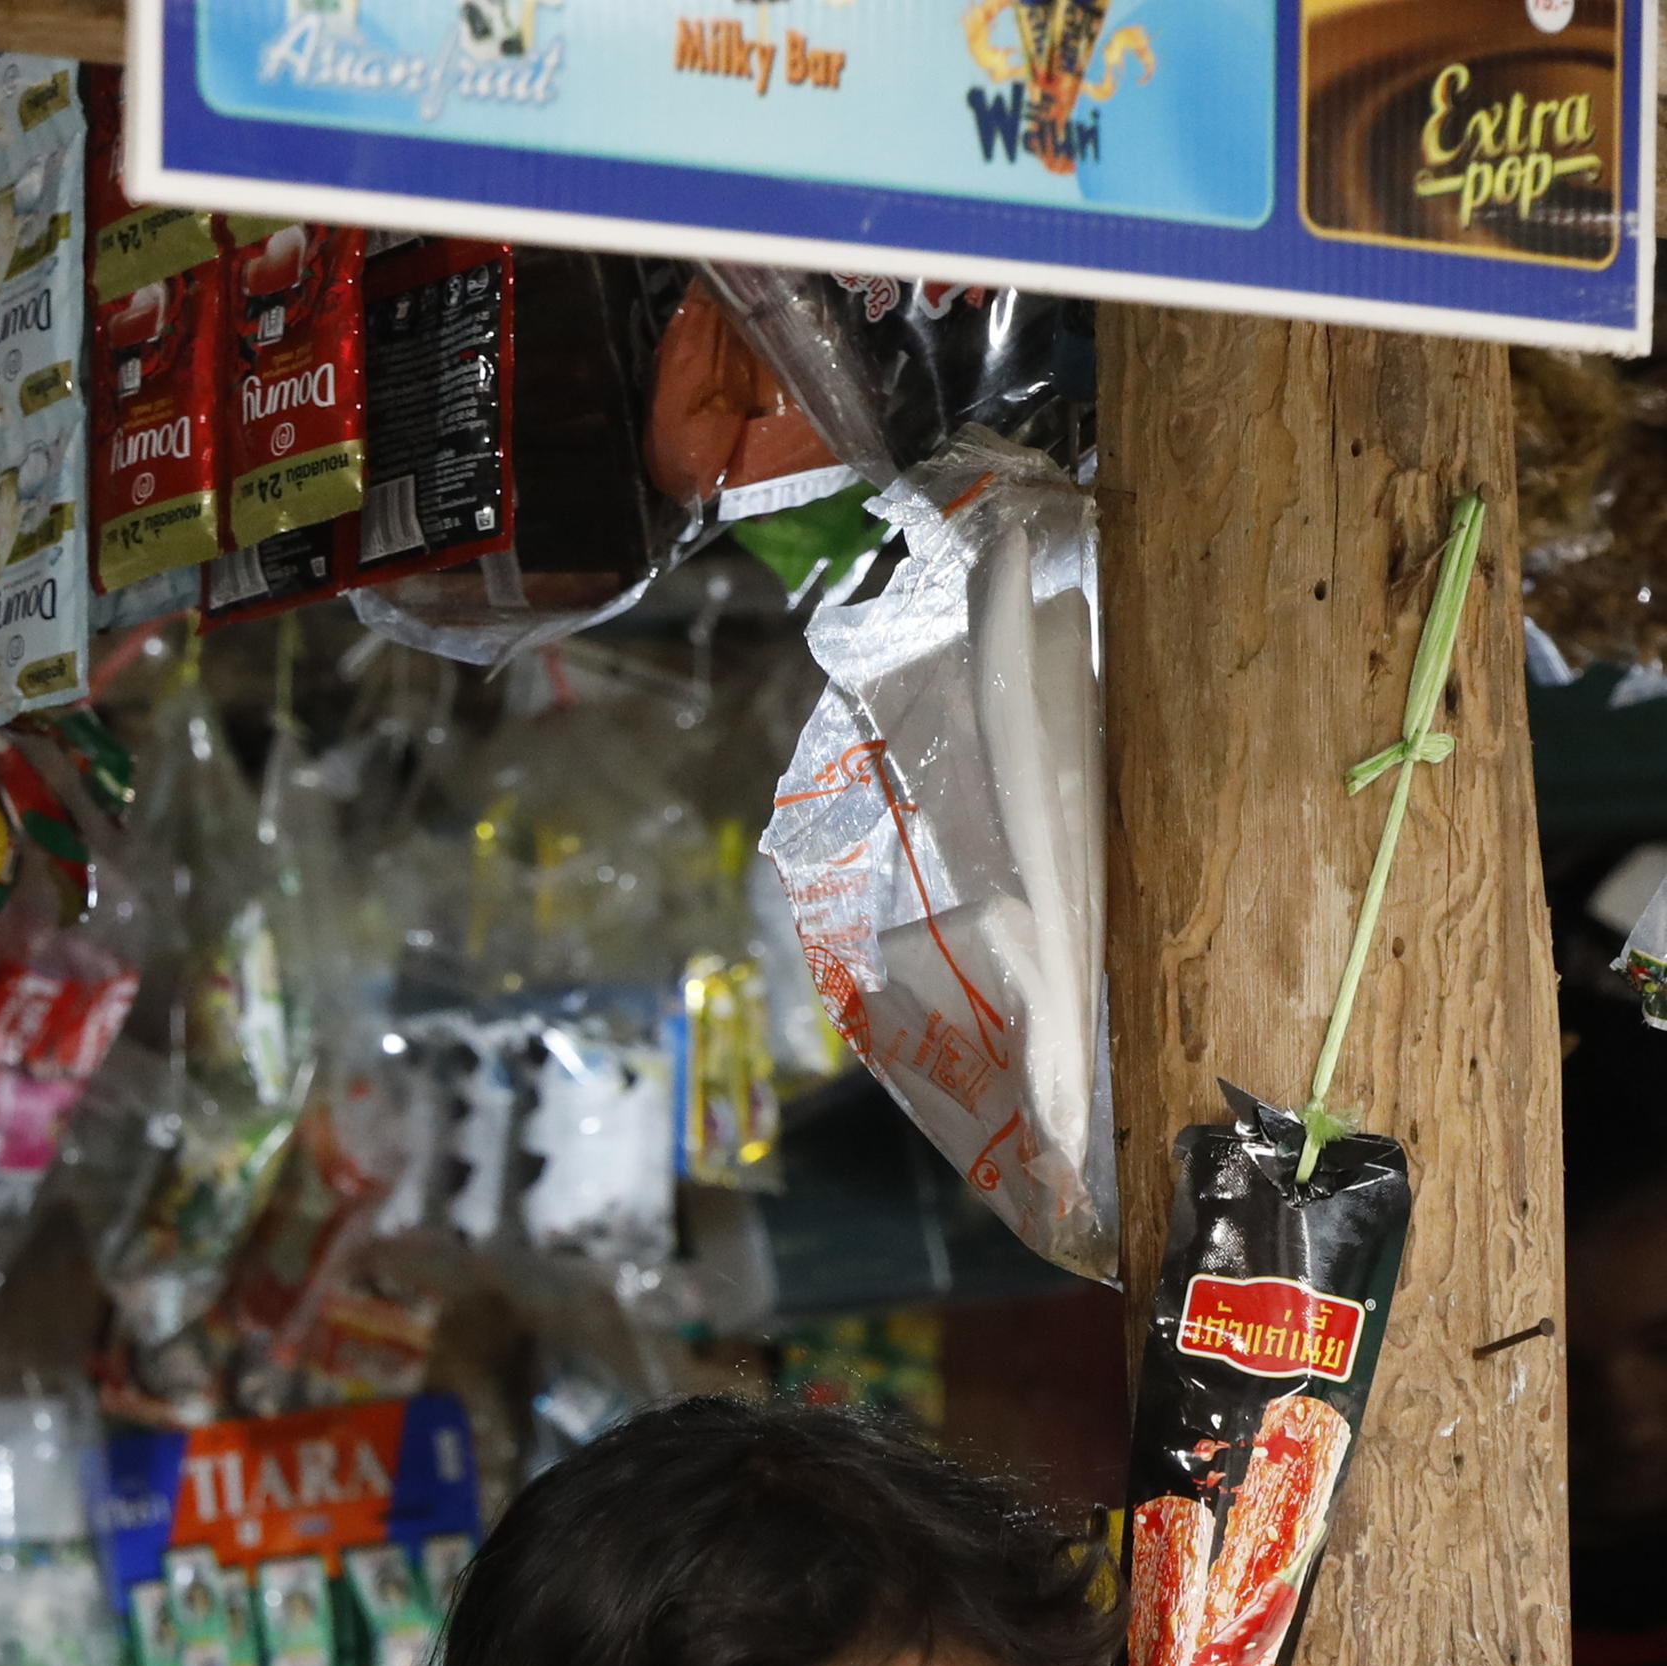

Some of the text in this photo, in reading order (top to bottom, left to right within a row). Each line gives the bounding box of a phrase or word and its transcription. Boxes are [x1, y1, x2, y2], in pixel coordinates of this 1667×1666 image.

[674, 18, 847, 96] Milky Bar
[1422, 63, 1596, 166] Extra
[1460, 152, 1553, 230] pop
[117, 224, 141, 254] 24
[242, 362, 336, 425] Downy
[111, 415, 191, 475] Downy
[257, 473, 283, 501] 24
[118, 521, 142, 550] 24
[183, 1437, 394, 1523] TIARA
